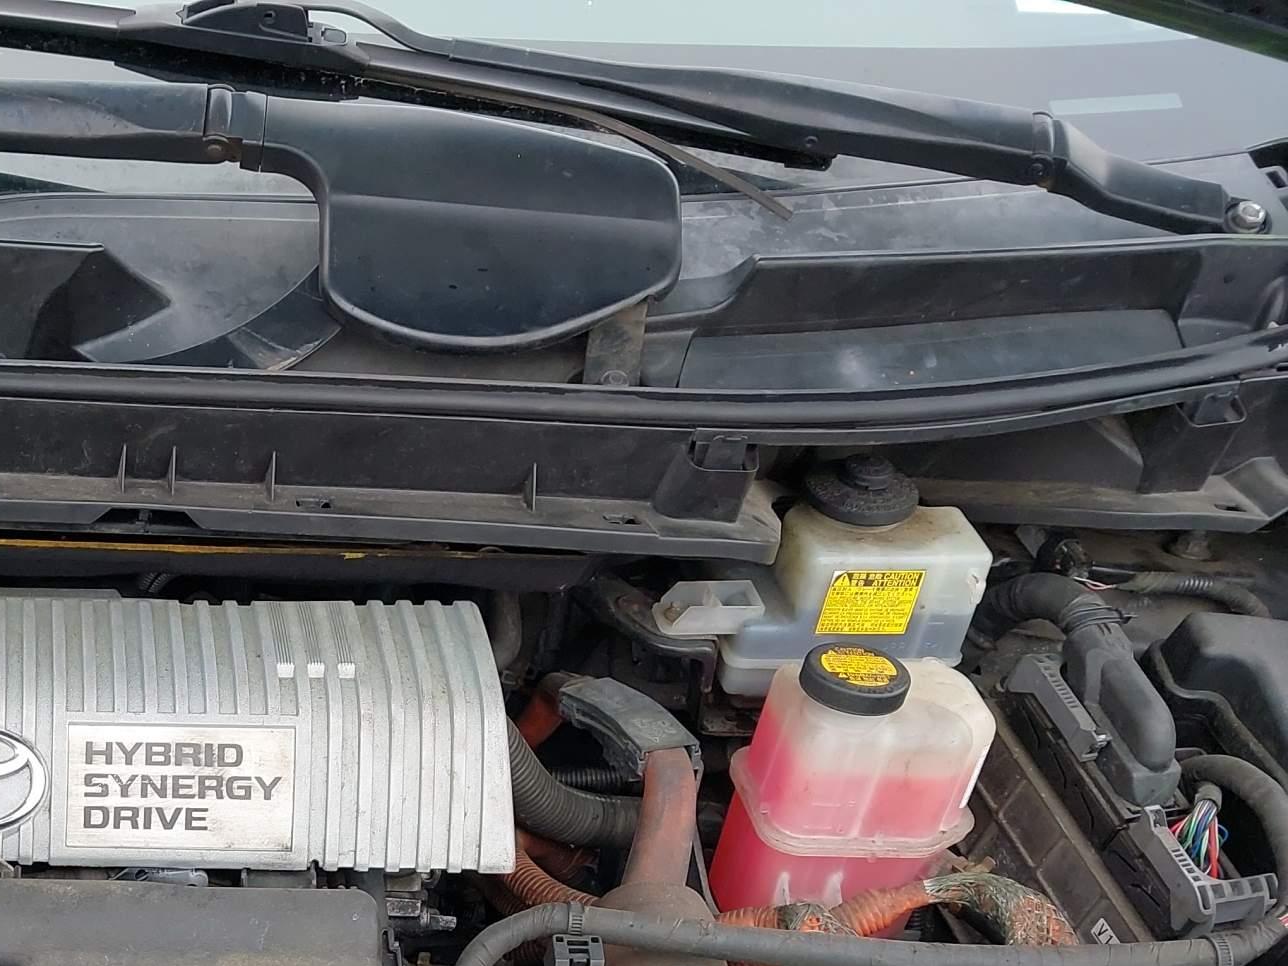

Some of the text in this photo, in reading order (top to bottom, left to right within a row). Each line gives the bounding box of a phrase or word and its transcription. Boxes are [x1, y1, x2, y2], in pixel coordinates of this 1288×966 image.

[85, 741, 244, 767] HYBRID
[83, 773, 282, 801] SYNERGY
[83, 806, 209, 831] DRIVE
